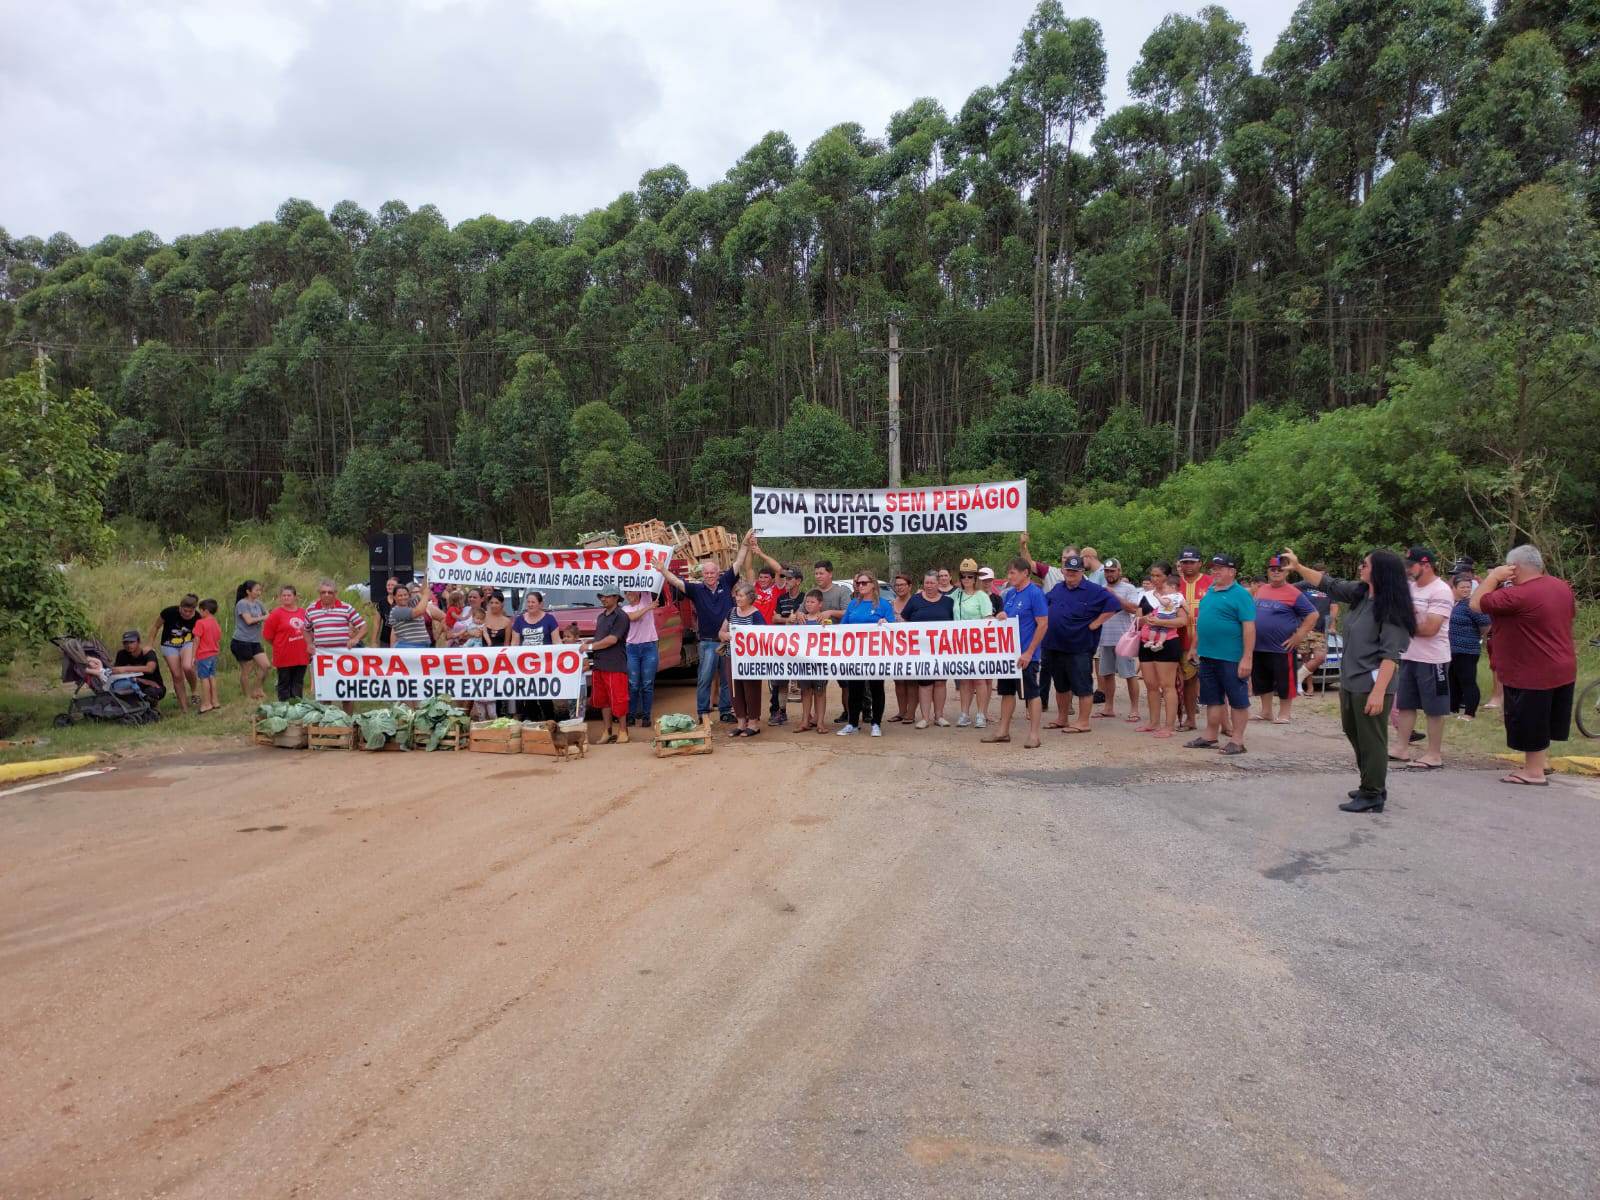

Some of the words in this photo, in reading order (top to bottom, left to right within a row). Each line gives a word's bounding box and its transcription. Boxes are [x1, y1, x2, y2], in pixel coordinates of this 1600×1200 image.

[754, 492, 808, 514] ZONA
[814, 493, 880, 514] RURAL
[886, 491, 926, 512] SEM
[933, 484, 1020, 511] PEDÁGIO
[804, 514, 894, 534] DIREITOS
[902, 512, 968, 532] IGUAIS
[438, 568, 446, 579] O
[448, 569, 472, 581] POVO
[474, 568, 493, 582] NÃO
[495, 571, 536, 584] AGUENTA
[538, 573, 560, 586] MAIS
[562, 574, 590, 586] PAGAR
[593, 575, 615, 586] ESSE
[618, 573, 654, 588] PEDÁGIO
[735, 632, 800, 656] SOMOS
[806, 630, 920, 656] PELOTENSE
[926, 621, 1014, 655] TAMBÉM
[316, 654, 410, 676] FORA
[420, 648, 580, 676] PEDÁGIO
[738, 662, 784, 676] QUEREMOS
[787, 662, 828, 676] SOMENTE
[830, 662, 838, 676] O
[840, 662, 876, 676] DIREITO
[878, 662, 891, 676] DE
[894, 662, 903, 676] IR
[906, 662, 912, 675] E
[915, 661, 930, 676] VIR
[933, 658, 940, 675] À
[942, 660, 976, 675] NOSSA
[978, 660, 1016, 674] CIDADE
[336, 679, 391, 698] CHEGA
[397, 679, 418, 698] DE
[424, 678, 456, 698] SER
[461, 677, 561, 698] EXPLORADO
